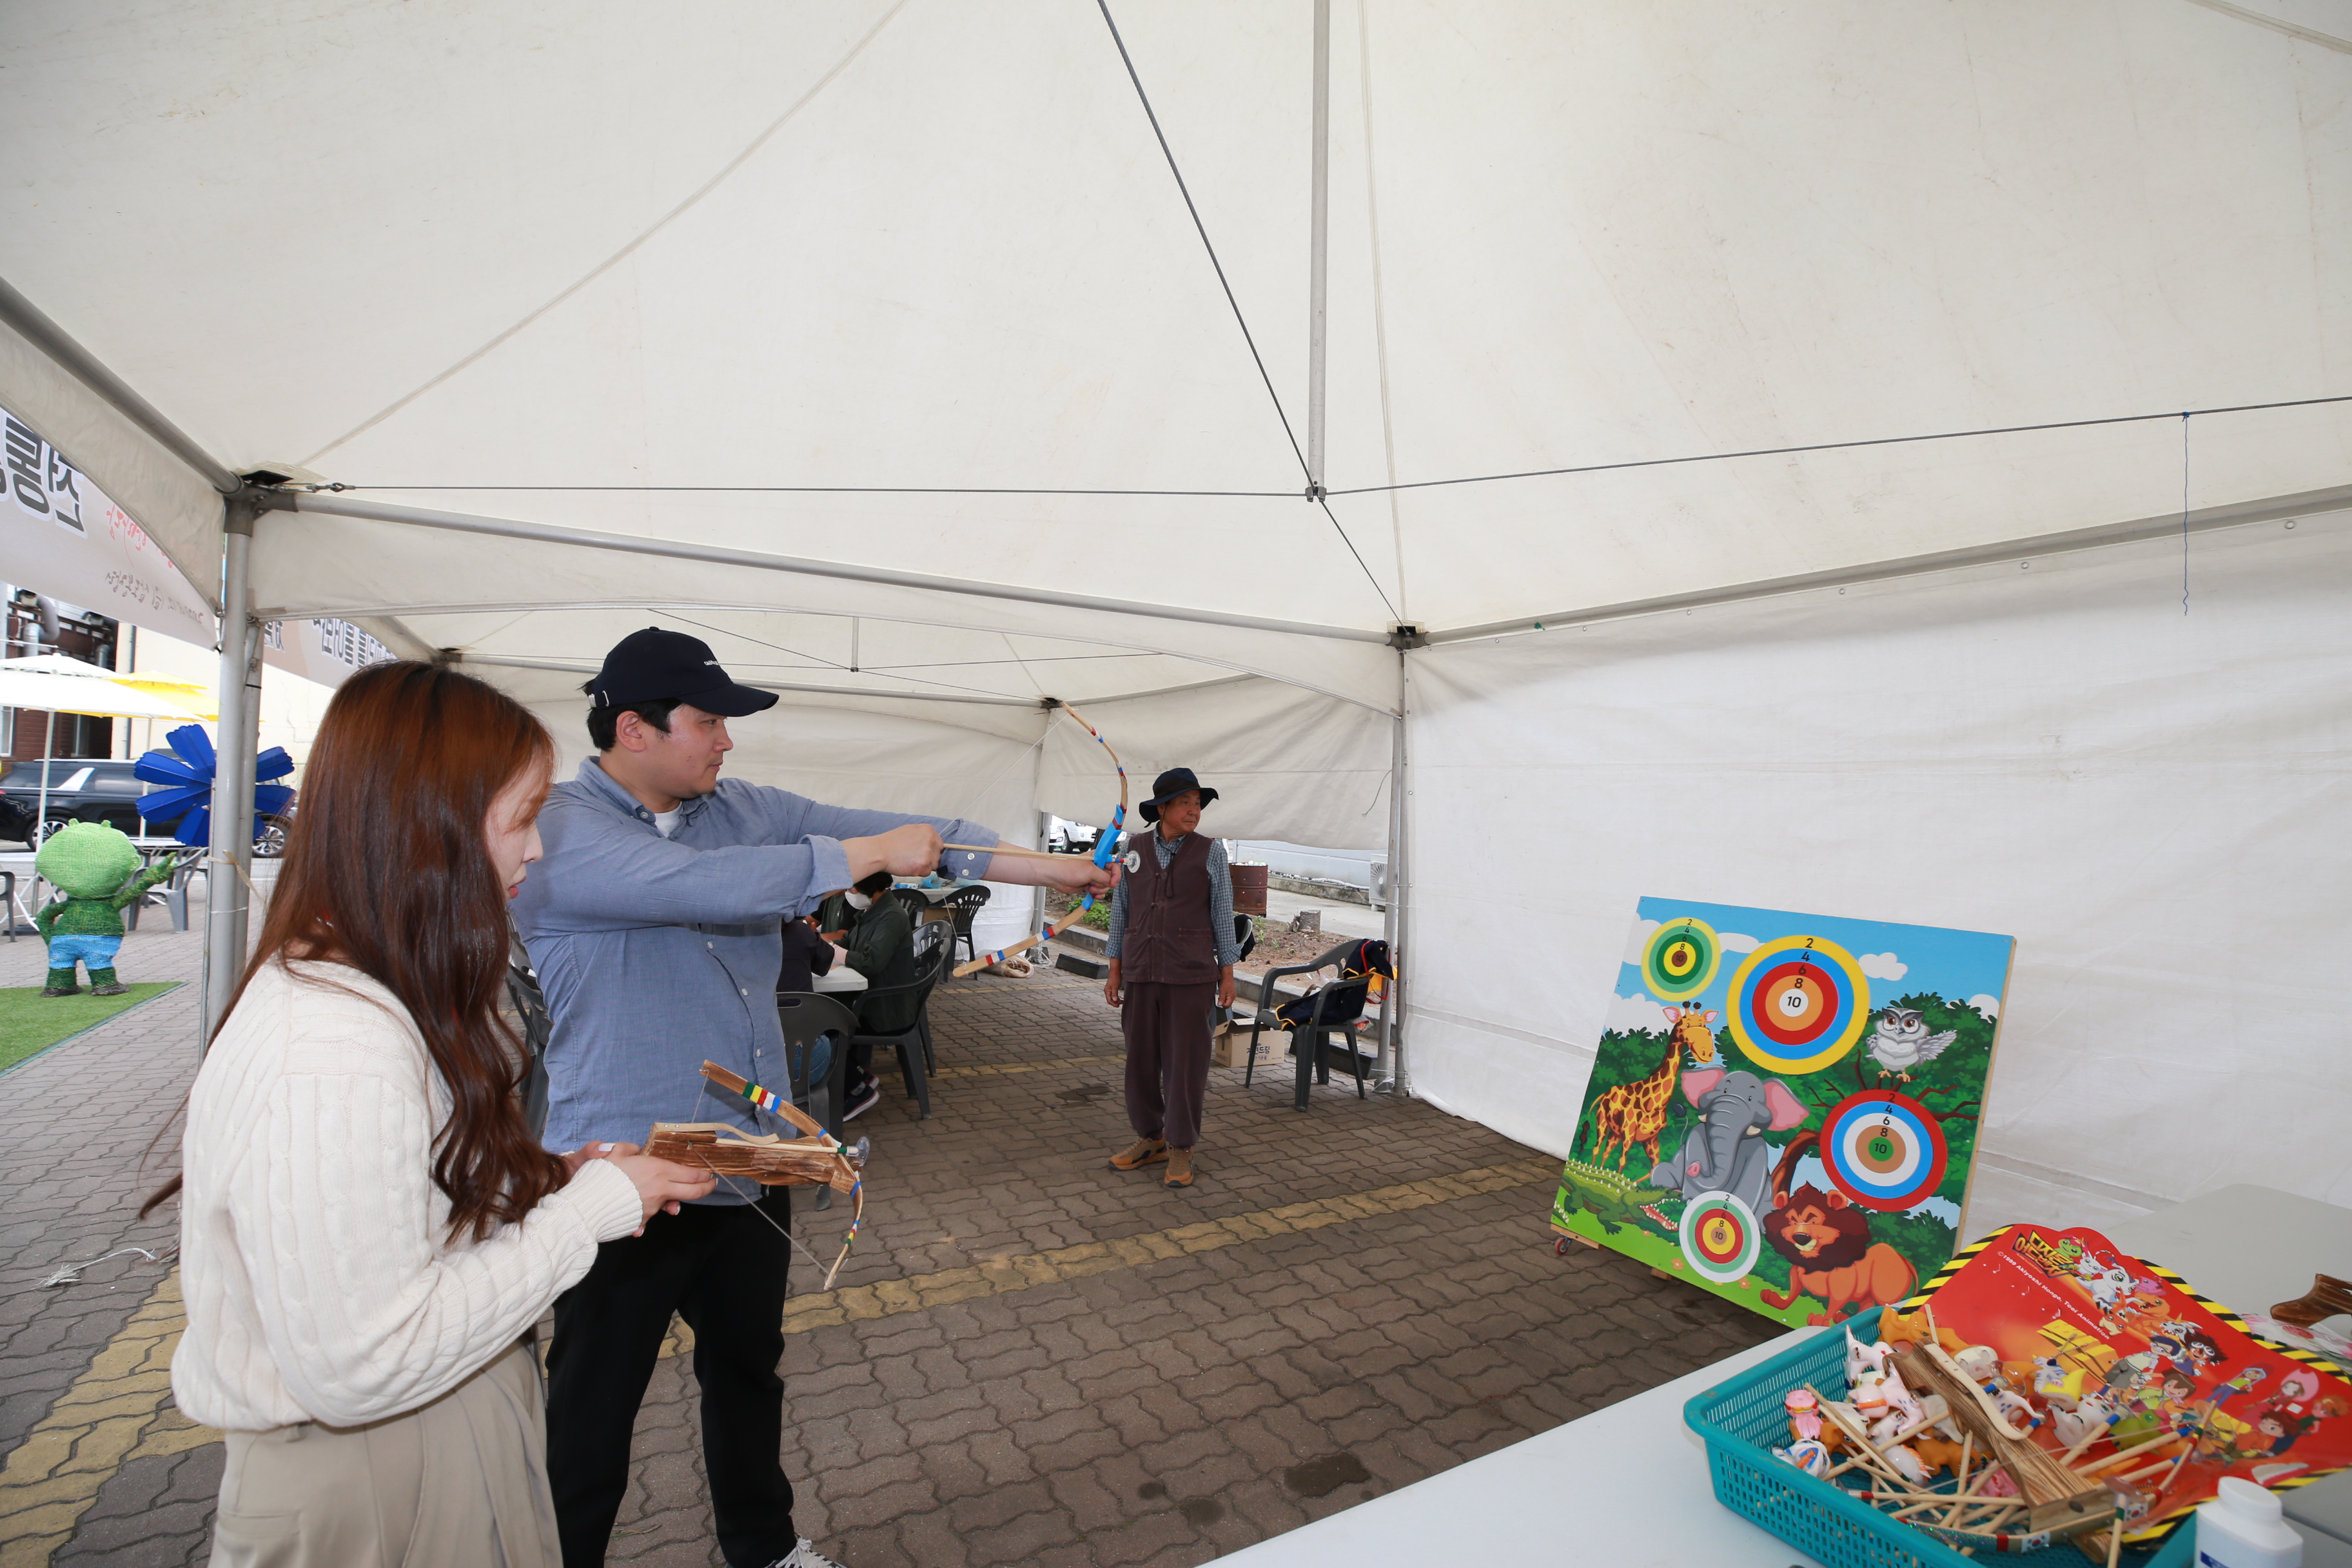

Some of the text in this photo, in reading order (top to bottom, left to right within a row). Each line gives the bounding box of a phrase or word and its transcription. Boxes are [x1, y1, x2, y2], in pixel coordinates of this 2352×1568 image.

[1805, 937, 1814, 948] 2
[1801, 951, 1810, 961] 4
[1798, 965, 1807, 975] 6
[1794, 978, 1803, 988] 8
[1787, 996, 1801, 1008] 10
[1888, 1093, 1896, 1102] 2
[1885, 1104, 1893, 1114] 4
[1883, 1116, 1890, 1125] 6
[1880, 1128, 1888, 1137] 8
[1875, 1143, 1887, 1154] 10
[1715, 1231, 1723, 1240] 10
[2029, 1231, 2074, 1265] 디지몬
[2015, 1265, 2041, 1286] Akiyoshi
[2064, 1300, 2079, 1313] Toei
[2077, 1311, 2110, 1340] Animation
